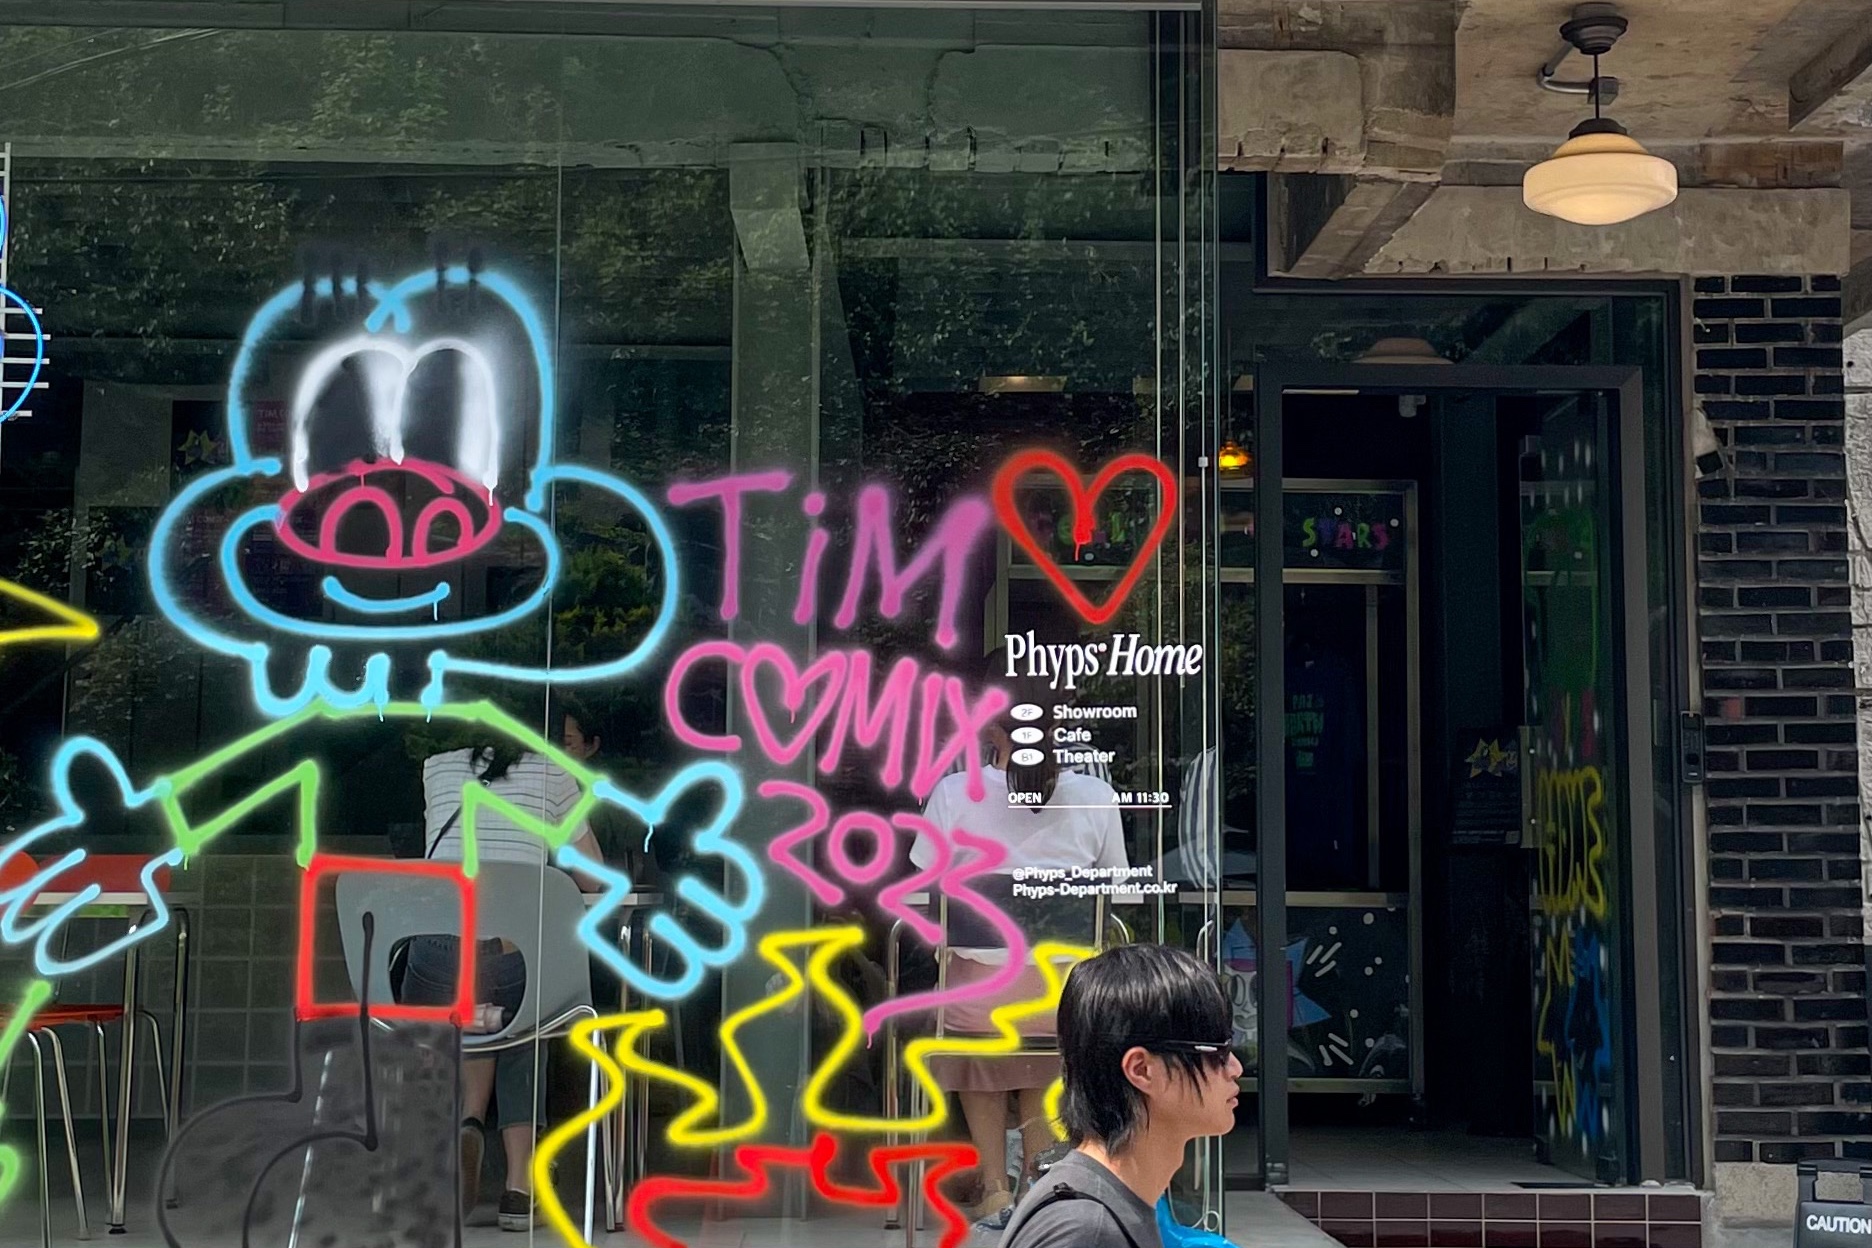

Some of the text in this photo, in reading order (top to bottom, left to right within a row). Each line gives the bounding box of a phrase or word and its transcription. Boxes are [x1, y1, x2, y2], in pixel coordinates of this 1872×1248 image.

[1053, 705, 1137, 719] Showroom
[1054, 727, 1092, 742] Cafe
[1053, 750, 1115, 764] Theater
[1008, 792, 1170, 804] OPEN AM 11:30
[1012, 866, 1153, 881] @Phyps_Department
[1012, 881, 1178, 898] Phyps-Department.co.kr
[758, 781, 1026, 1040] 2023
[1806, 1215, 1872, 1234] CAUTION
